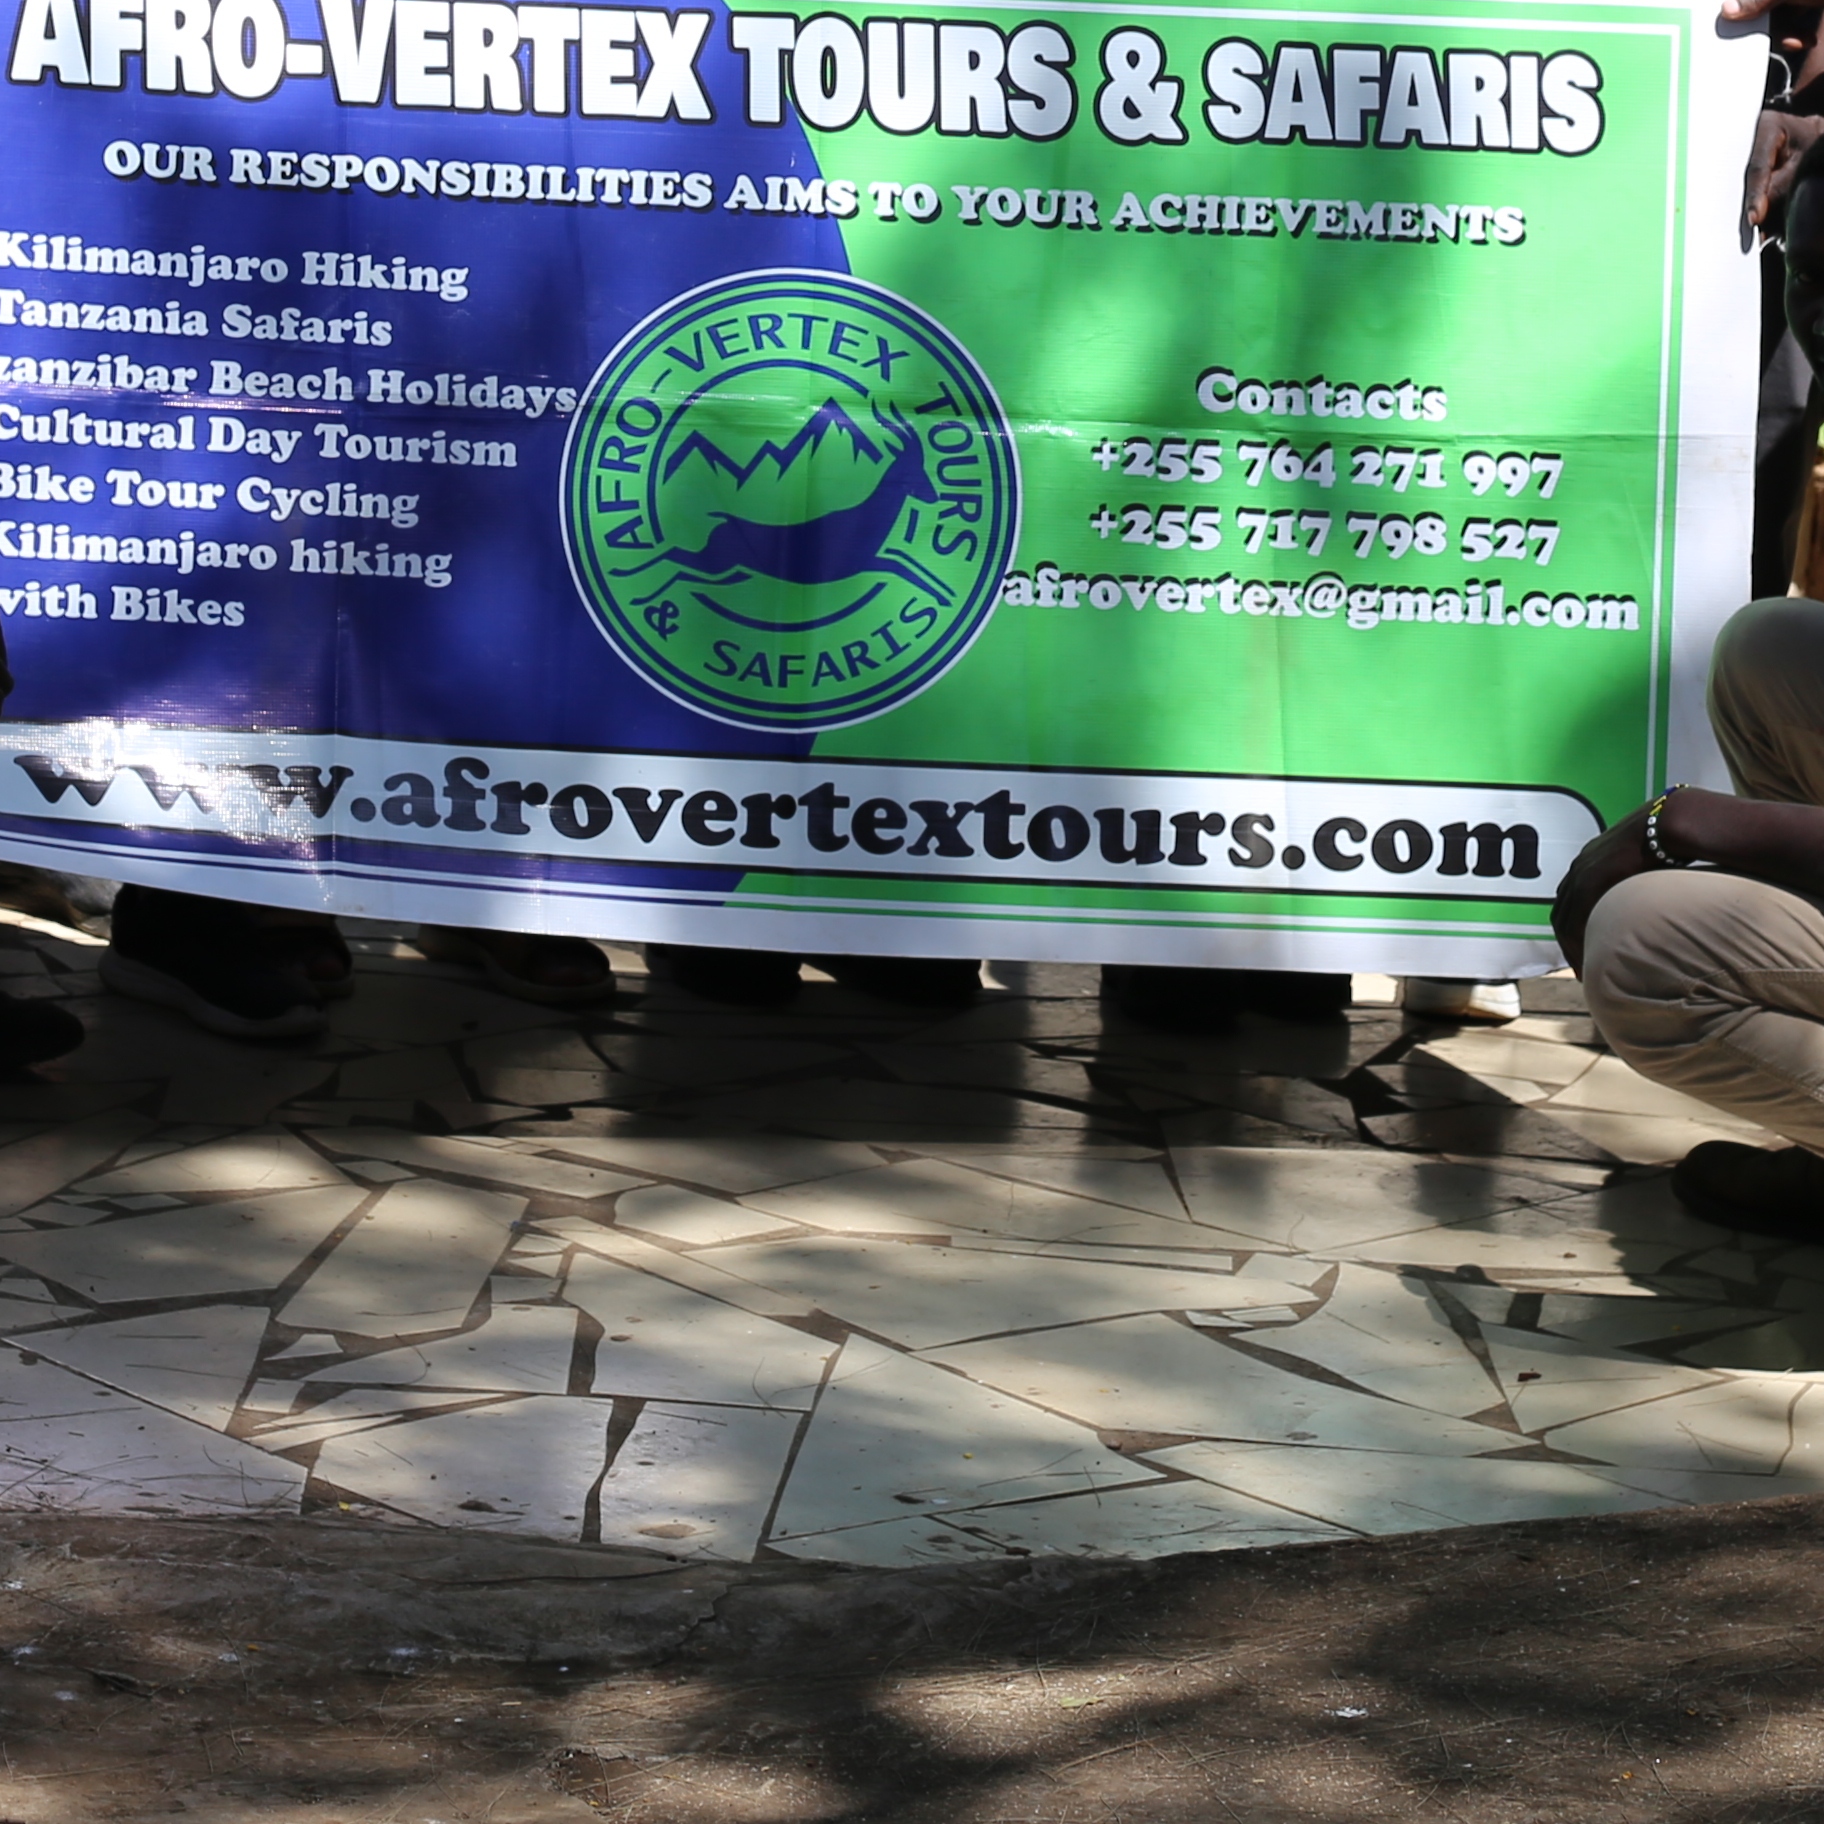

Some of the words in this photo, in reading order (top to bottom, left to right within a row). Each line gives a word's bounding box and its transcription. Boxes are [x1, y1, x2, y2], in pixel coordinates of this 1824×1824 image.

[728, 10, 1076, 143] TOURS
[1095, 24, 1189, 147] &
[1202, 35, 1606, 157] SAFARIS
[102, 139, 216, 184] OUR
[228, 149, 714, 213] RESPONSIBILITIES
[723, 174, 858, 219] AIMS
[870, 181, 940, 224] TO
[952, 184, 1099, 232] YOUR
[1109, 191, 1526, 246] ACHIEVEMENTS
[300, 251, 470, 303] Hiking
[221, 303, 393, 348] Safaris
[208, 359, 362, 404] Beach
[366, 371, 578, 417] Holidays
[1196, 366, 1449, 424] Contacts
[207, 415, 302, 464] Day
[314, 423, 519, 468] Tourism
[1090, 436, 1223, 485] +255
[1236, 437, 1337, 489] 764
[1349, 444, 1447, 493] 271
[1461, 449, 1564, 500] 997
[104, 469, 225, 511] Tour
[236, 477, 420, 528] Cycling
[913, 381, 983, 563] TOURS
[290, 539, 454, 588] hiking
[1089, 503, 1223, 552] +255
[1235, 505, 1332, 558] 717
[1346, 511, 1447, 560] 798
[1459, 517, 1562, 567] 527
[109, 585, 246, 629] Bikes
[1003, 560, 1641, 631] afrovertex@gmail.com
[643, 599, 680, 641] &
[703, 596, 939, 689] SAFARIS
